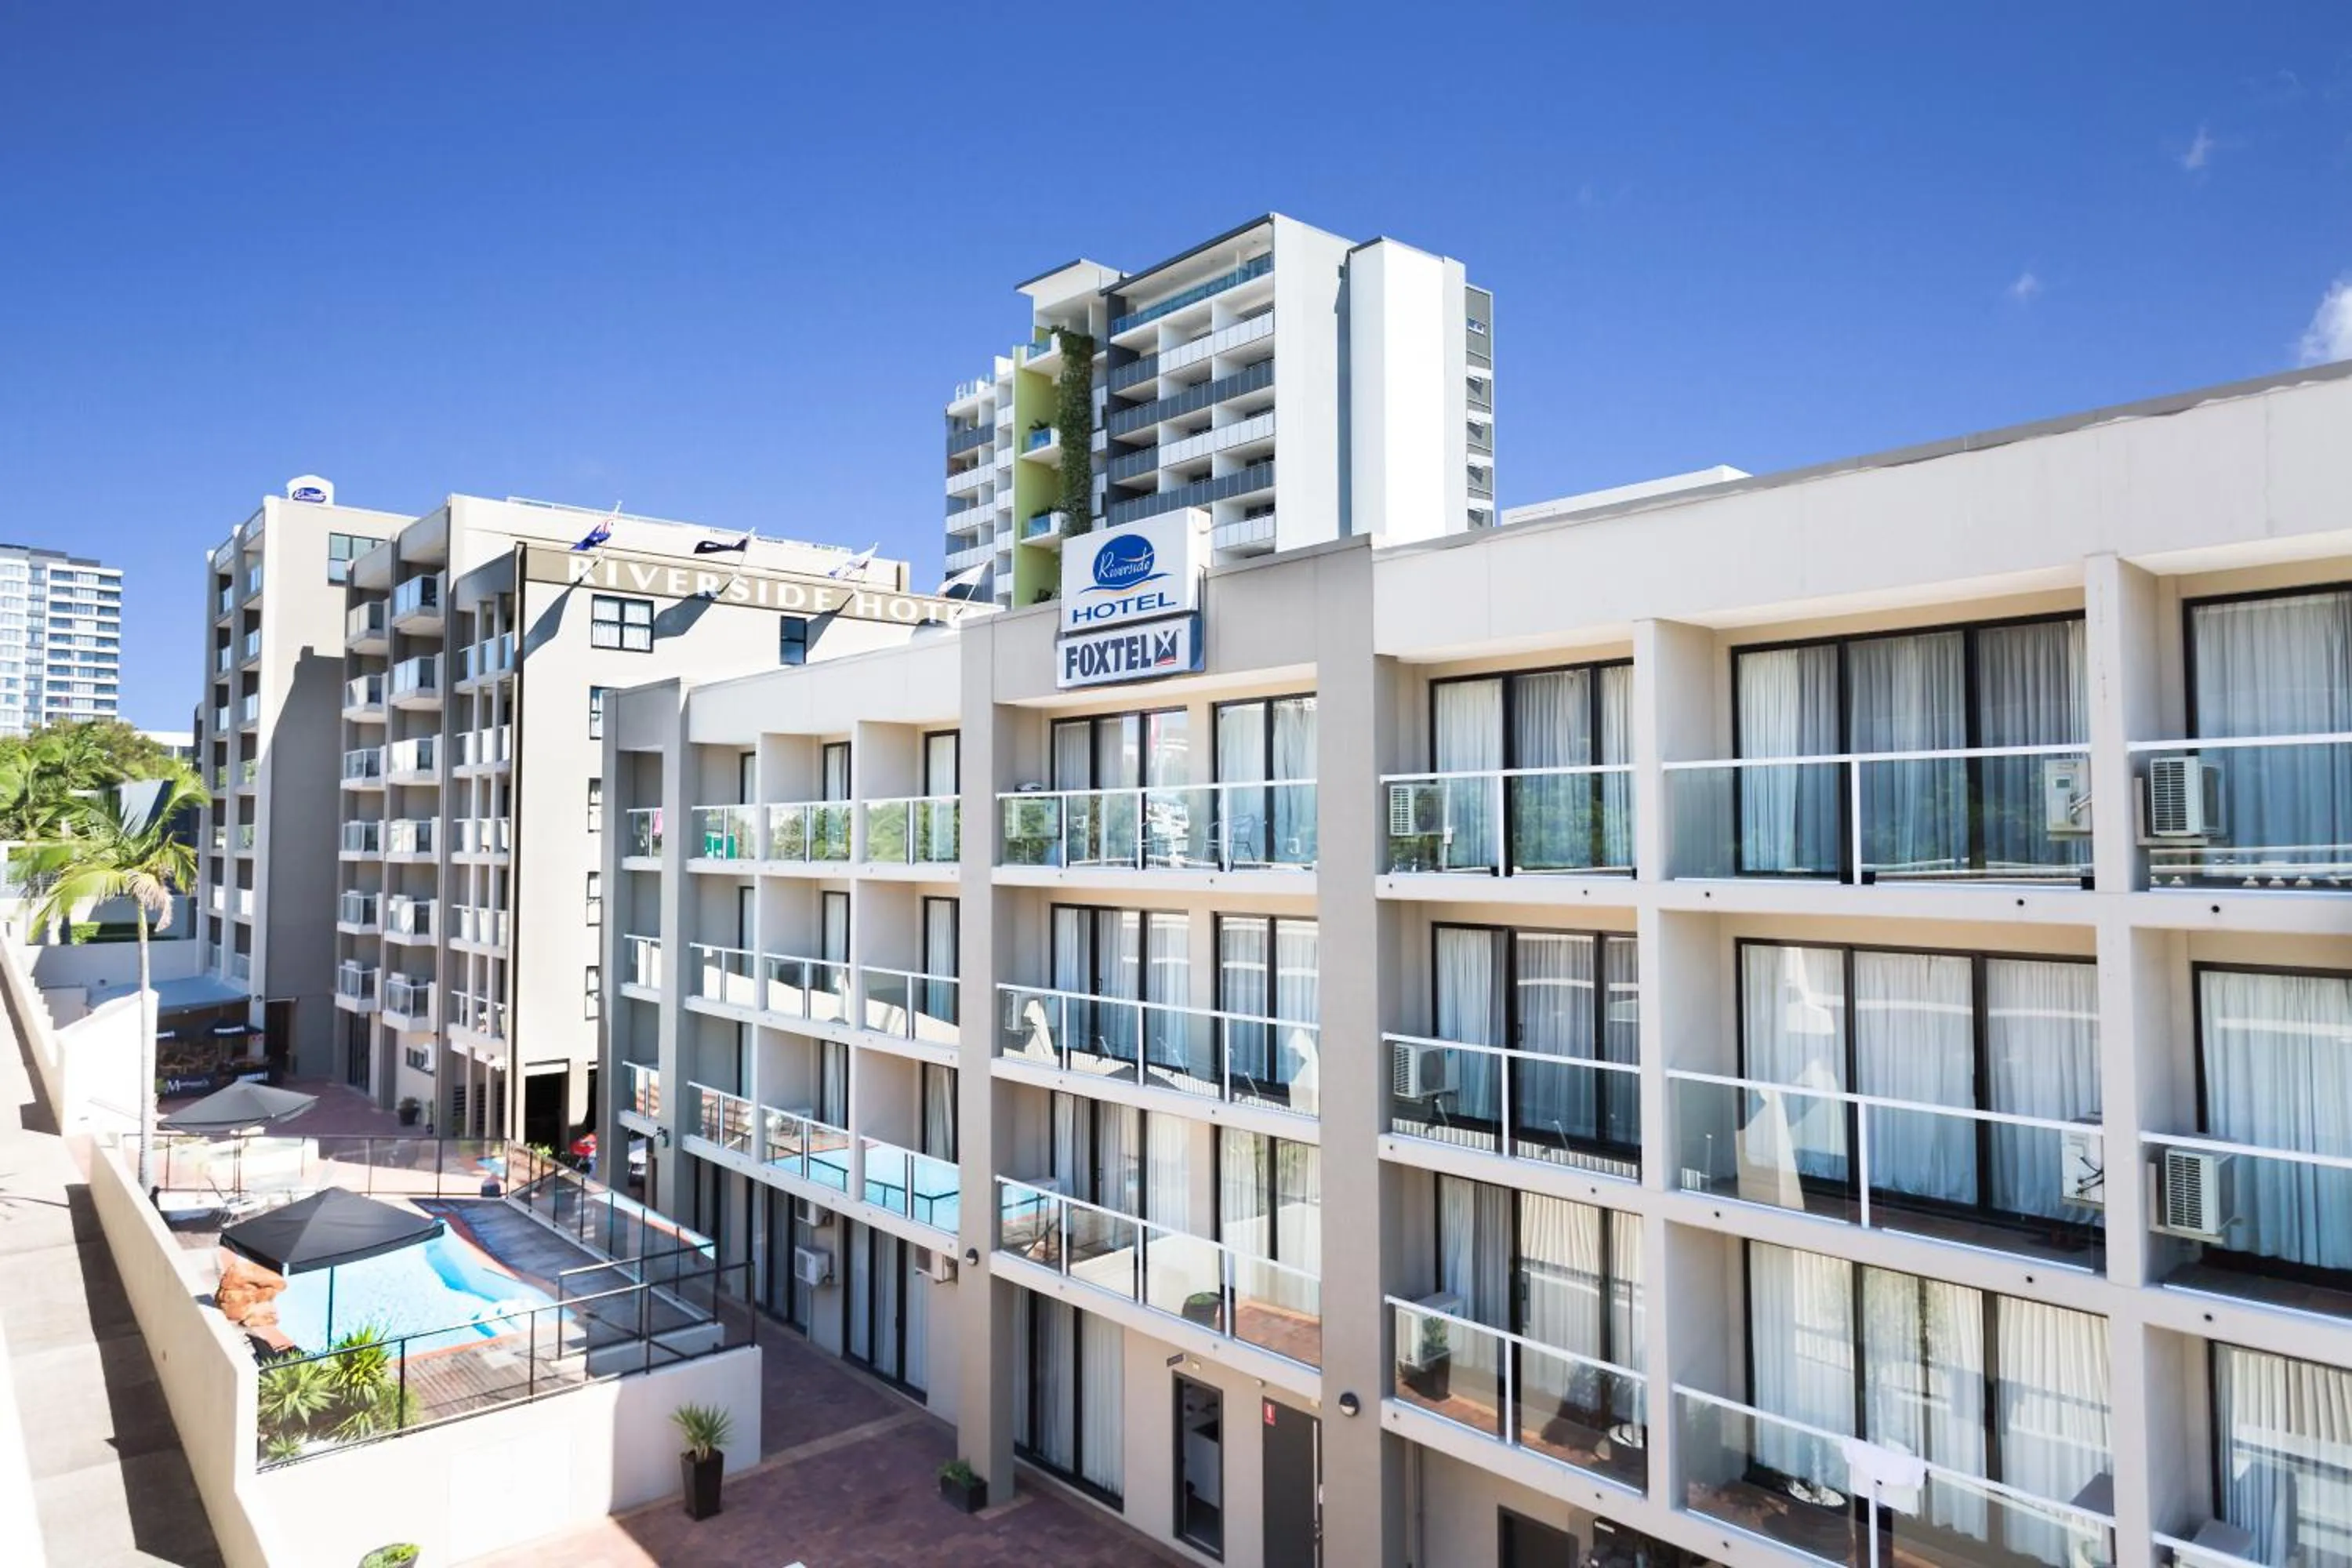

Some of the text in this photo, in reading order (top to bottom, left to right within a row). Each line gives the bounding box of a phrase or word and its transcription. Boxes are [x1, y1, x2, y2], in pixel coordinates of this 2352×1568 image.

[568, 555, 833, 612] RIVERSIDE
[1072, 592, 1177, 623] HOTEL
[1065, 633, 1152, 680] FOXTEL
